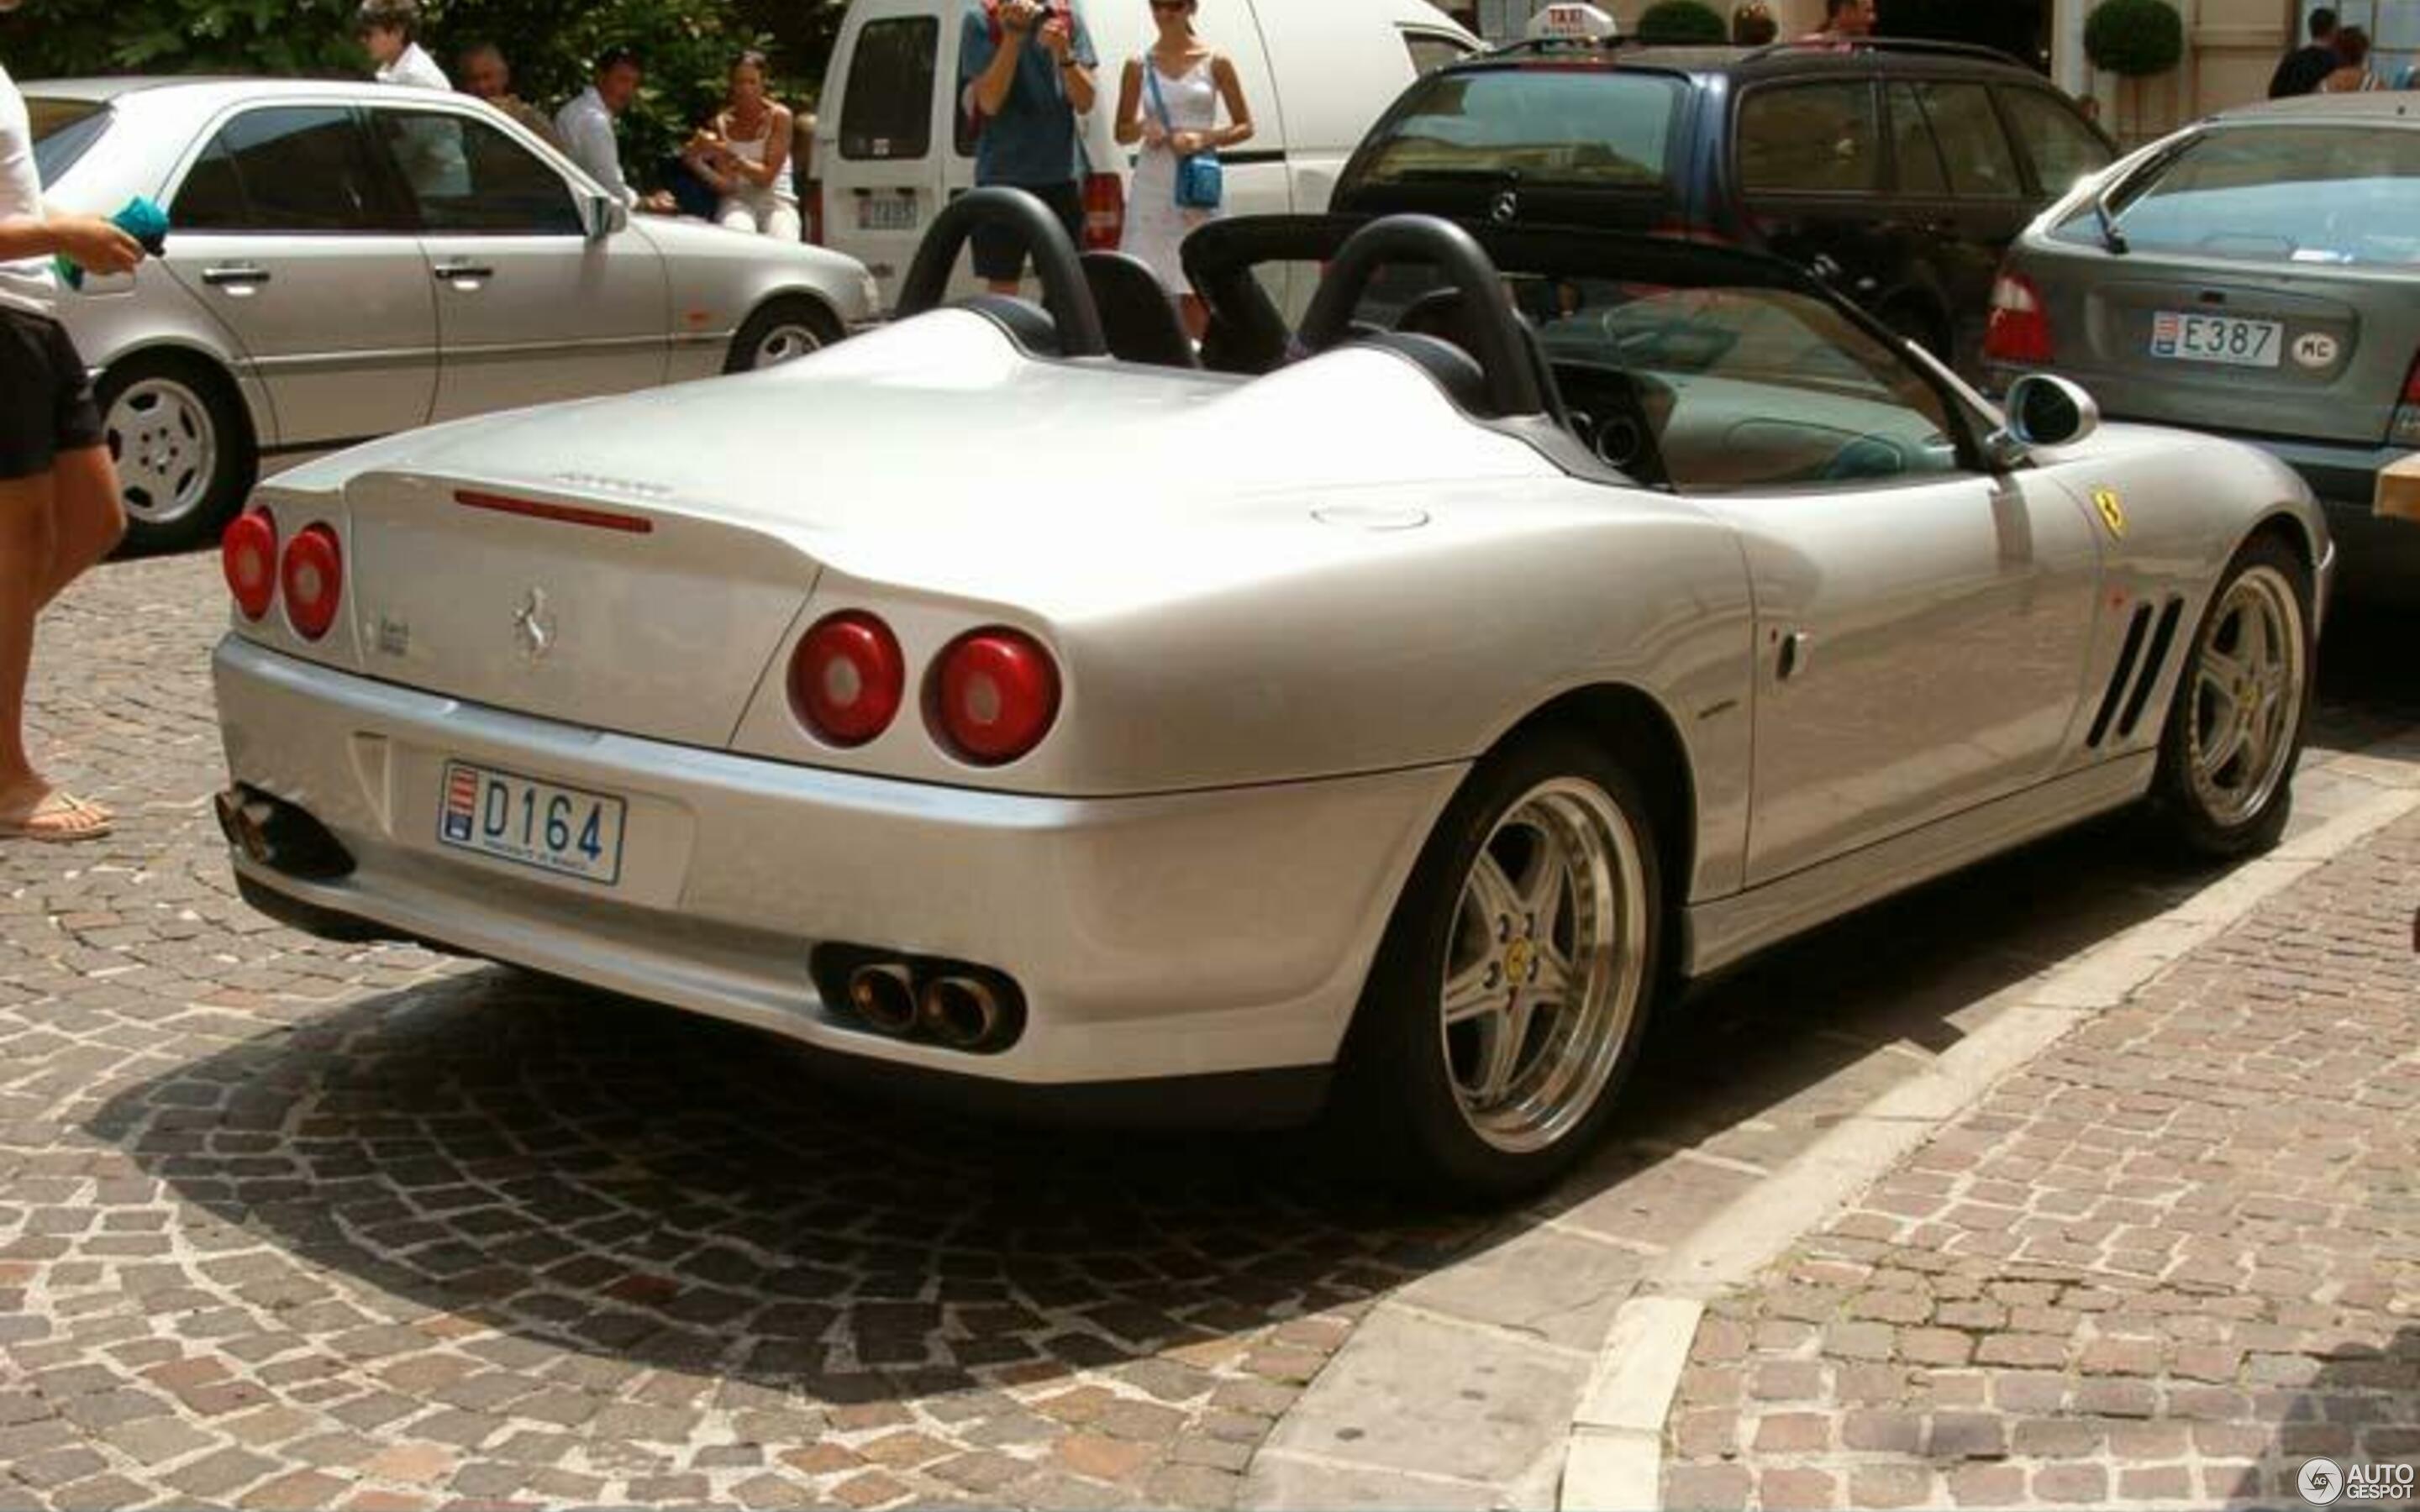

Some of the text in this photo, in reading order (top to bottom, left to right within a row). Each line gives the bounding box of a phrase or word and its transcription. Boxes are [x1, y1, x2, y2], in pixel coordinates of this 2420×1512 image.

[2184, 318, 2272, 358] E387
[2301, 342, 2328, 356] MC
[483, 779, 602, 861] D164
